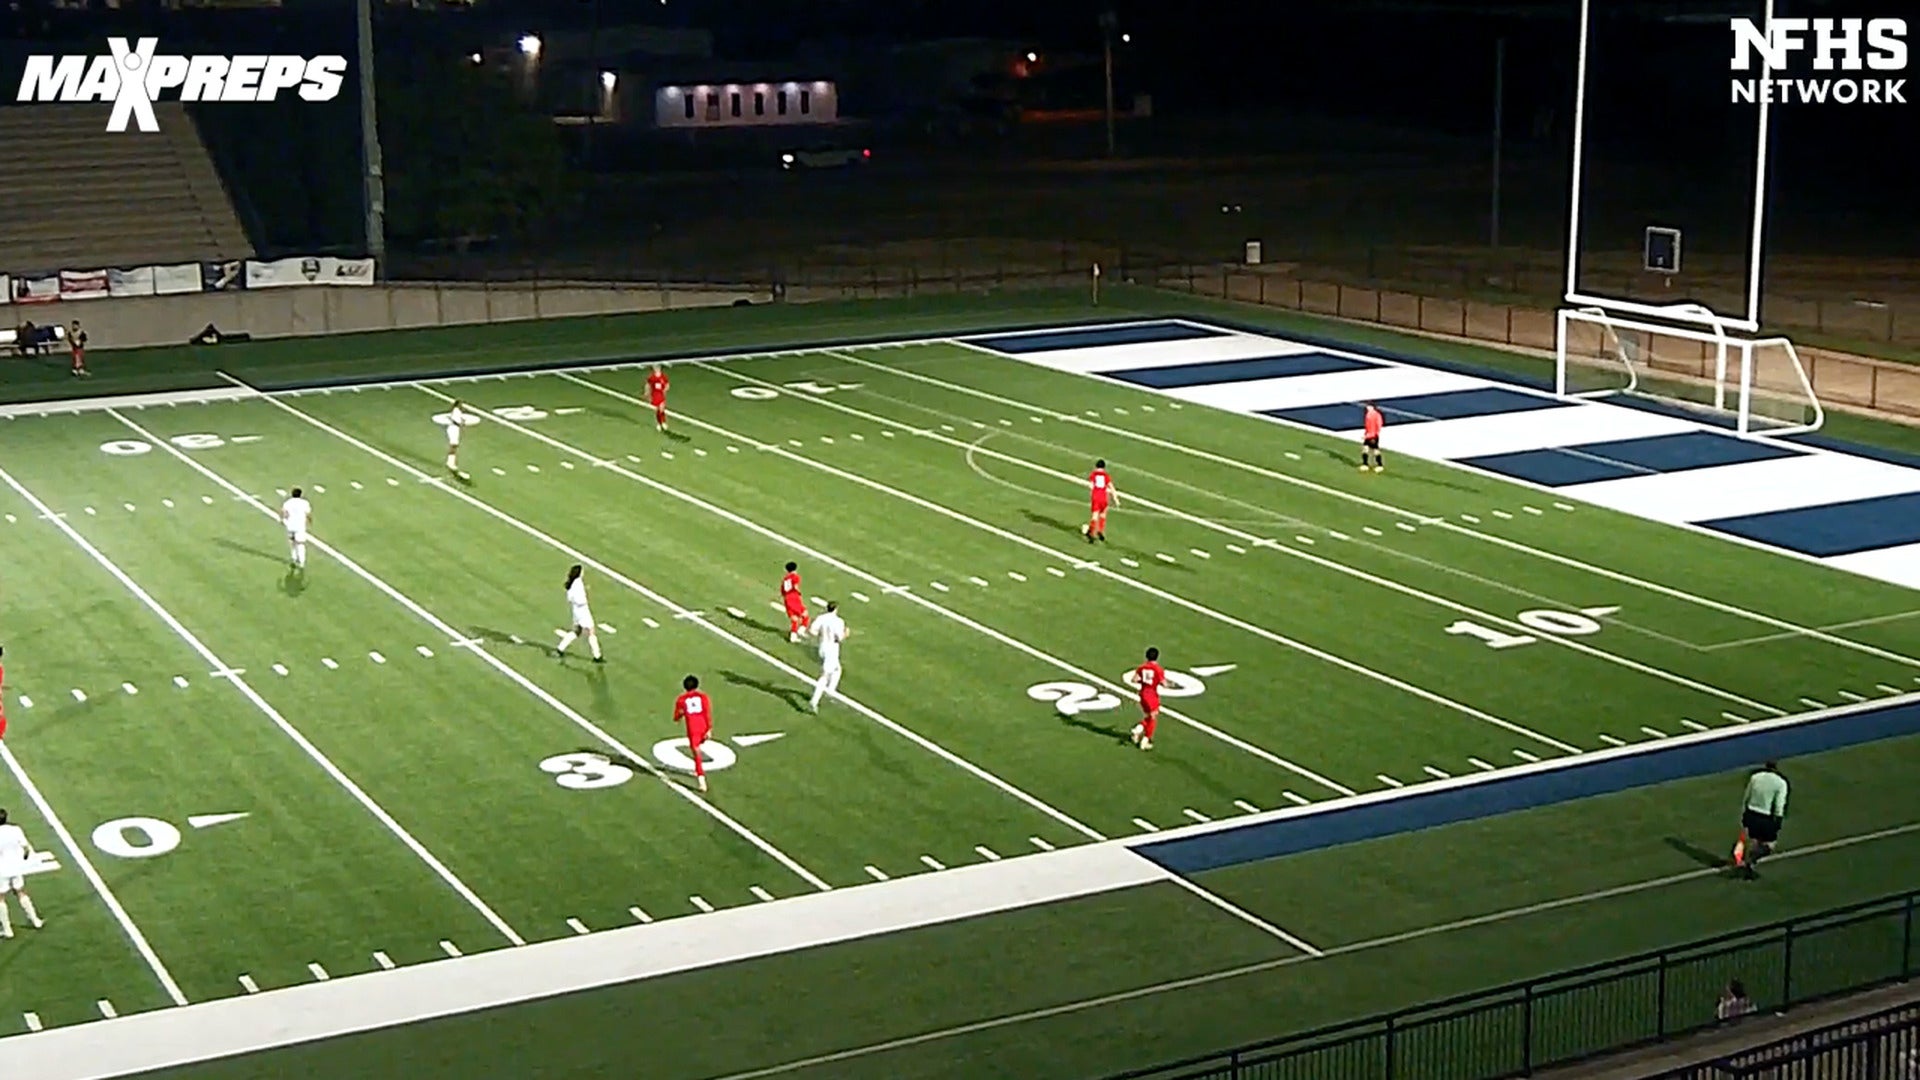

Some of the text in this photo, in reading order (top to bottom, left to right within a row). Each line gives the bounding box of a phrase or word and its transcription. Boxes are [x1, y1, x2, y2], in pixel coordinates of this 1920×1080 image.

[1444, 610, 1600, 649] 10
[1027, 669, 1206, 715] 20
[539, 737, 737, 789] 30
